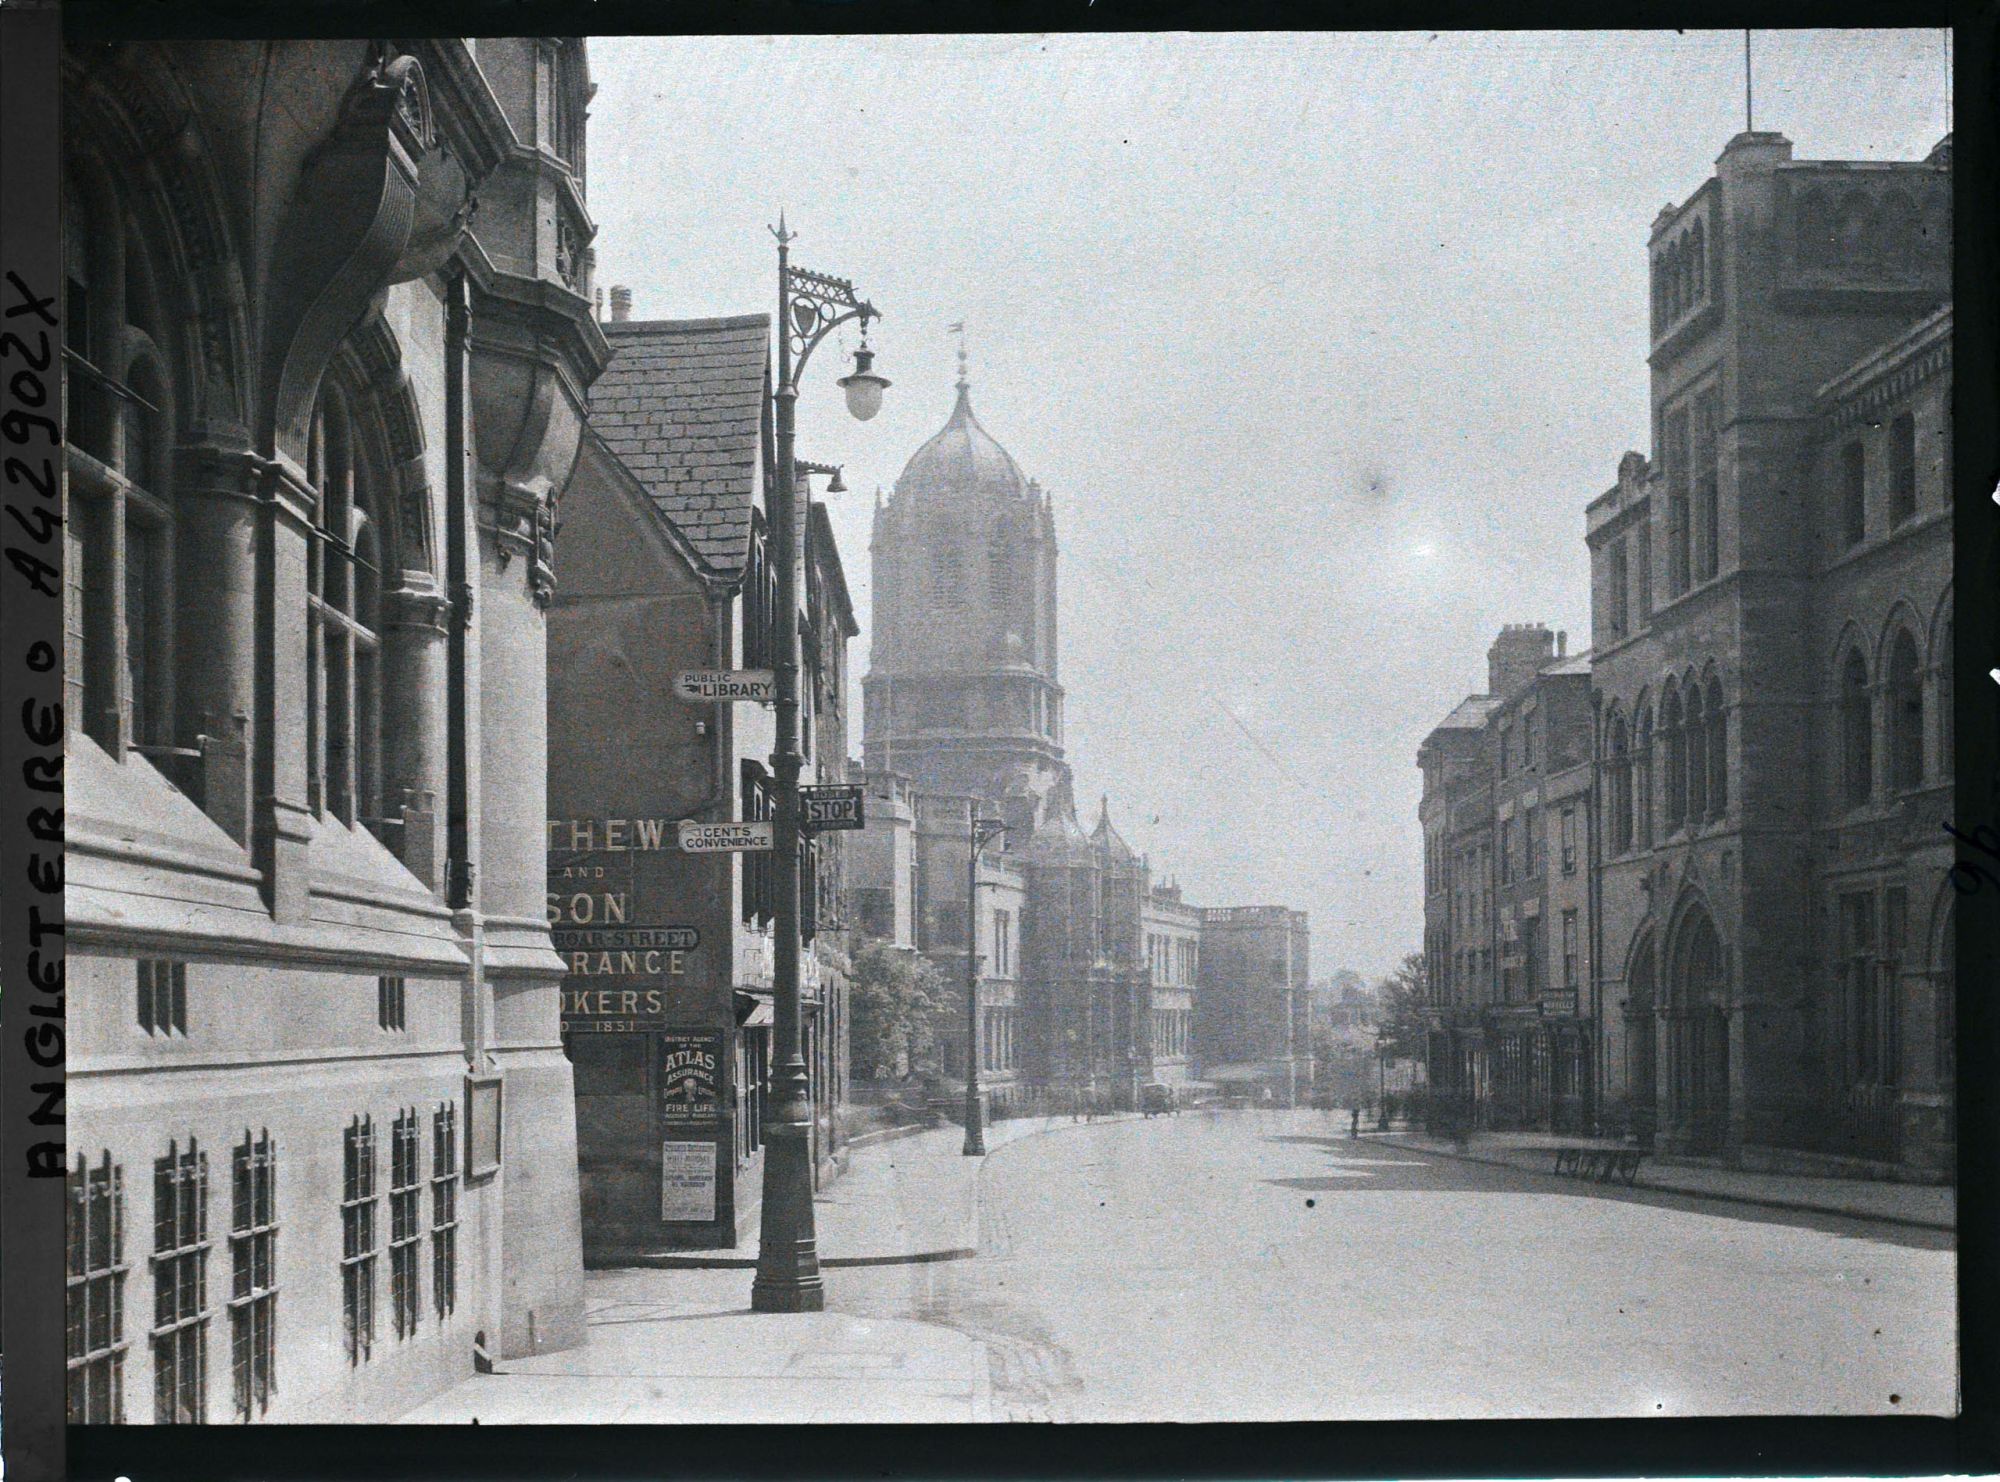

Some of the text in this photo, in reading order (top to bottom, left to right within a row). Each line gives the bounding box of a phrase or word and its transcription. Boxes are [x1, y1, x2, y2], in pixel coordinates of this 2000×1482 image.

[4, 271, 62, 594] A42902X
[684, 674, 732, 683] PUBLIC
[703, 682, 772, 697] LIBRARY
[810, 801, 853, 819] STOP
[686, 836, 769, 848] CONVENIENCE
[563, 866, 605, 879] AND
[24, 696, 66, 1178] ANGLETERRE
[596, 1021, 634, 1033] 1851
[665, 1050, 716, 1073] ATLAS
[667, 1068, 714, 1086] ASSURANCE
[665, 1103, 717, 1113] FIRE LIFE
